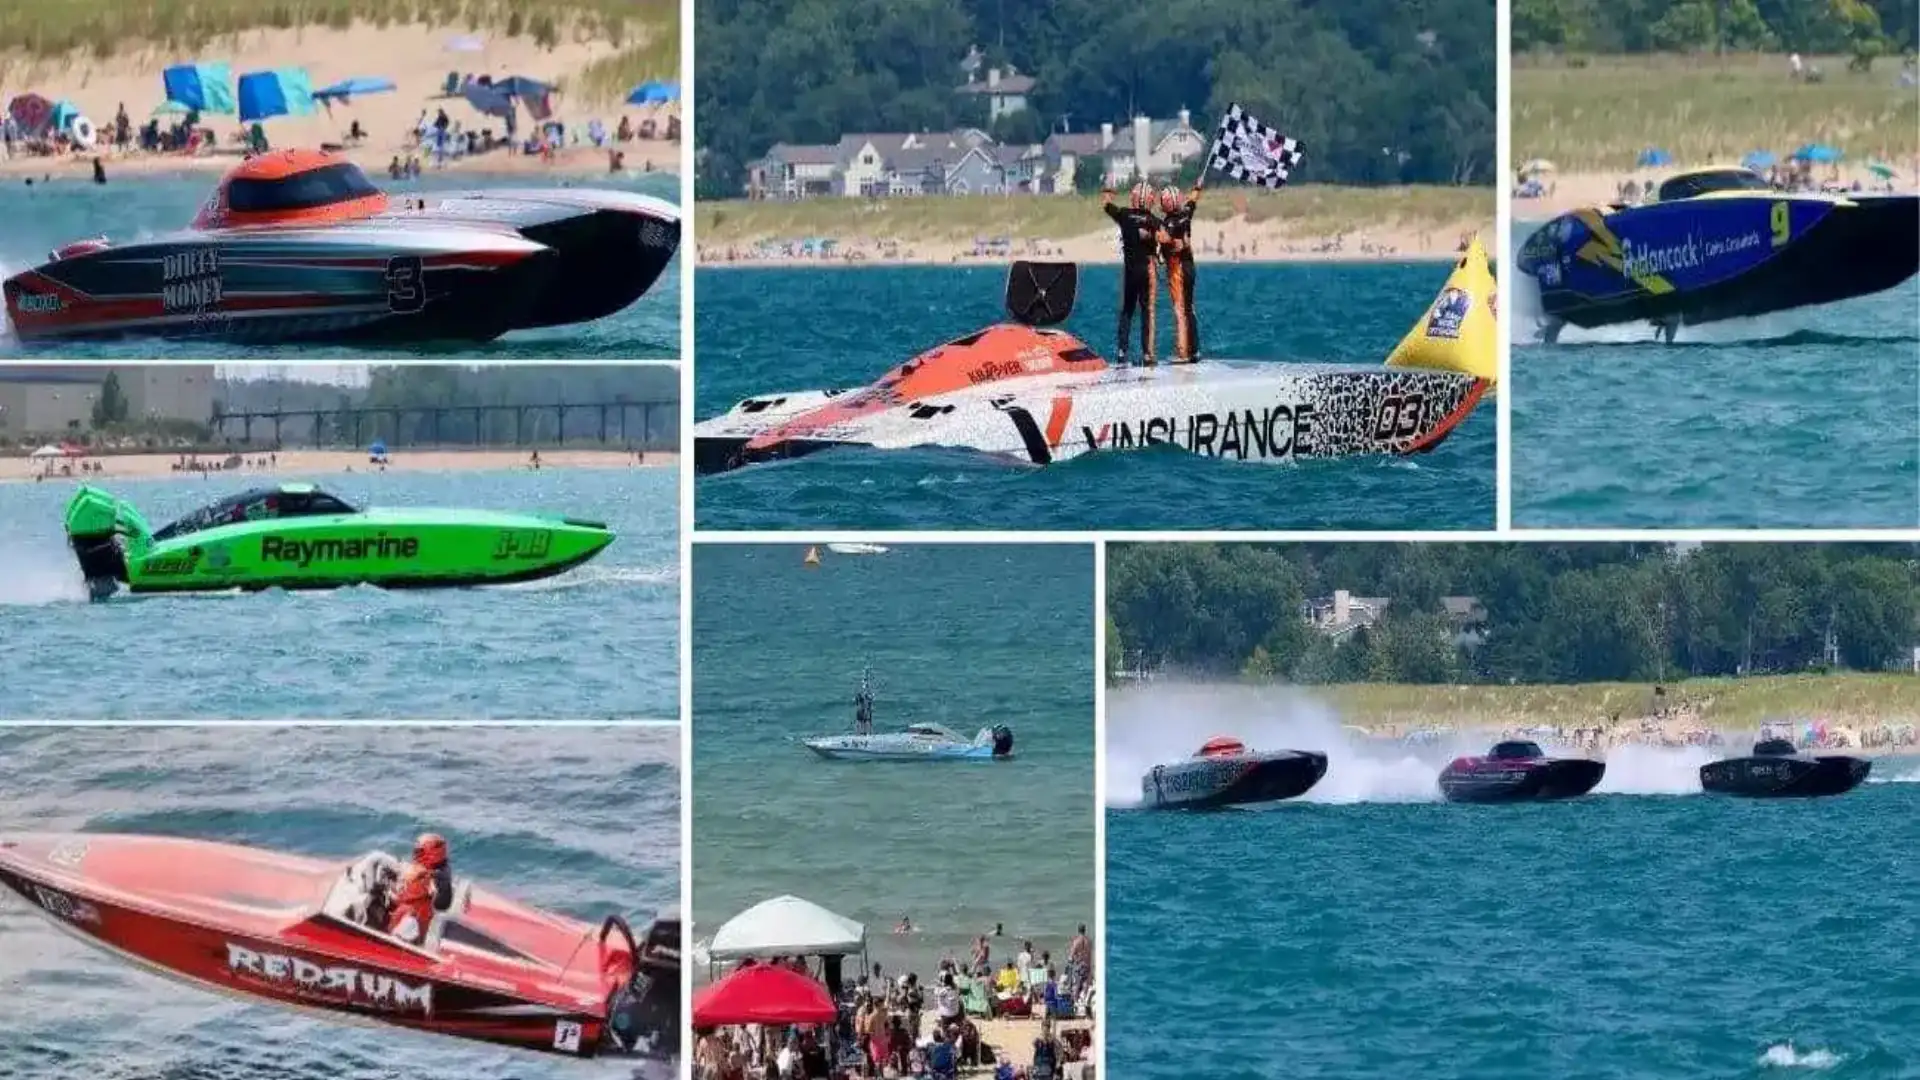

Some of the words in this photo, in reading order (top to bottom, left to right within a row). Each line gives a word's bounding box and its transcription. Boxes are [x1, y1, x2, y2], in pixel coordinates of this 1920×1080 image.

[1770, 201, 1790, 248] 9
[163, 275, 224, 308] MONEY
[384, 253, 426, 315] 3
[1373, 393, 1424, 440] 03
[261, 531, 419, 568] Raymarine
[226, 942, 434, 1018] REDRUM
